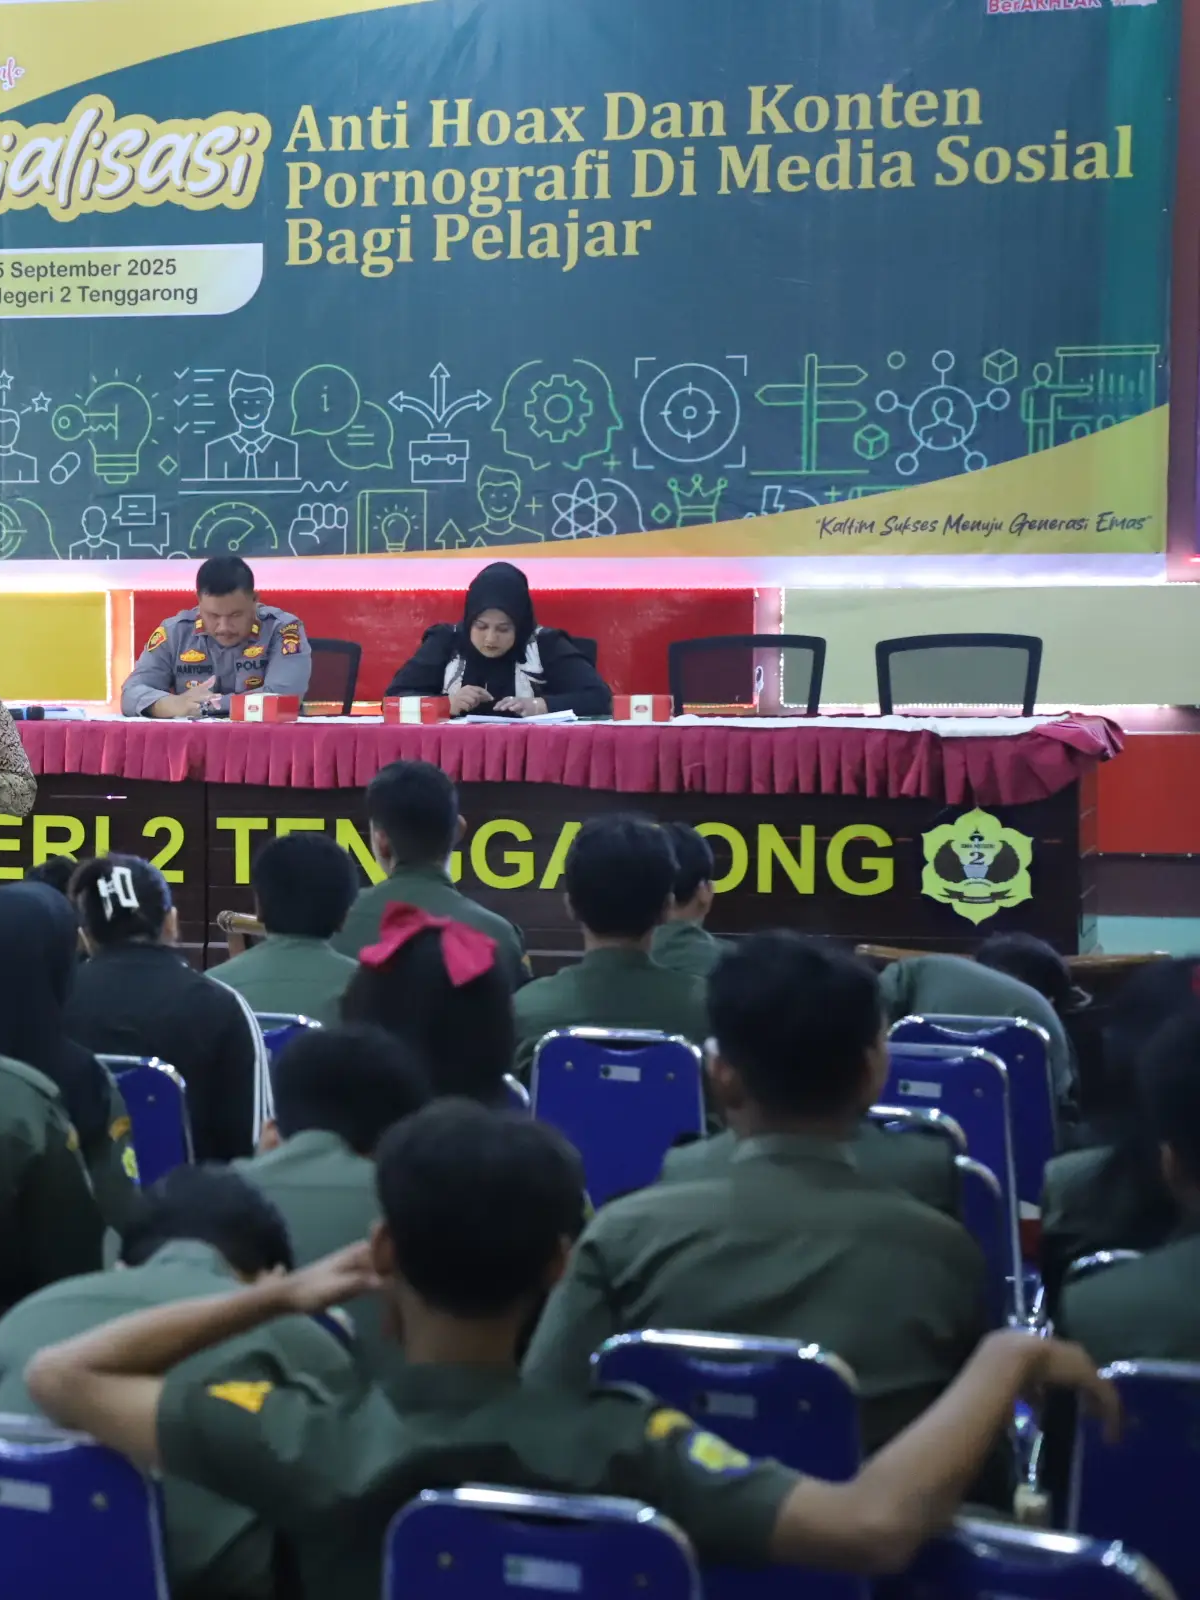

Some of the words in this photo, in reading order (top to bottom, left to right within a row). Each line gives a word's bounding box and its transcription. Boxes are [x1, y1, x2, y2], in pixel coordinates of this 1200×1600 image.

[283, 99, 411, 152] Anti
[429, 97, 585, 148] Hoax
[604, 91, 727, 141] Dan
[748, 84, 982, 135] Konten
[285, 148, 610, 218] Pornografi
[632, 146, 697, 198] Di
[718, 138, 915, 194] Media
[936, 125, 1133, 186] Sosial
[285, 214, 413, 278] Bagi
[433, 207, 652, 272] Pelajar
[10, 260, 122, 283] September
[127, 258, 177, 276] 2025
[60, 286, 72, 303] 2
[77, 285, 198, 307] Tenggarong
[880, 515, 937, 537] Sukses
[942, 513, 1003, 538] Menuju
[1008, 511, 1089, 536] Generasi
[142, 816, 185, 884] 2
[969, 851, 985, 865] 2
